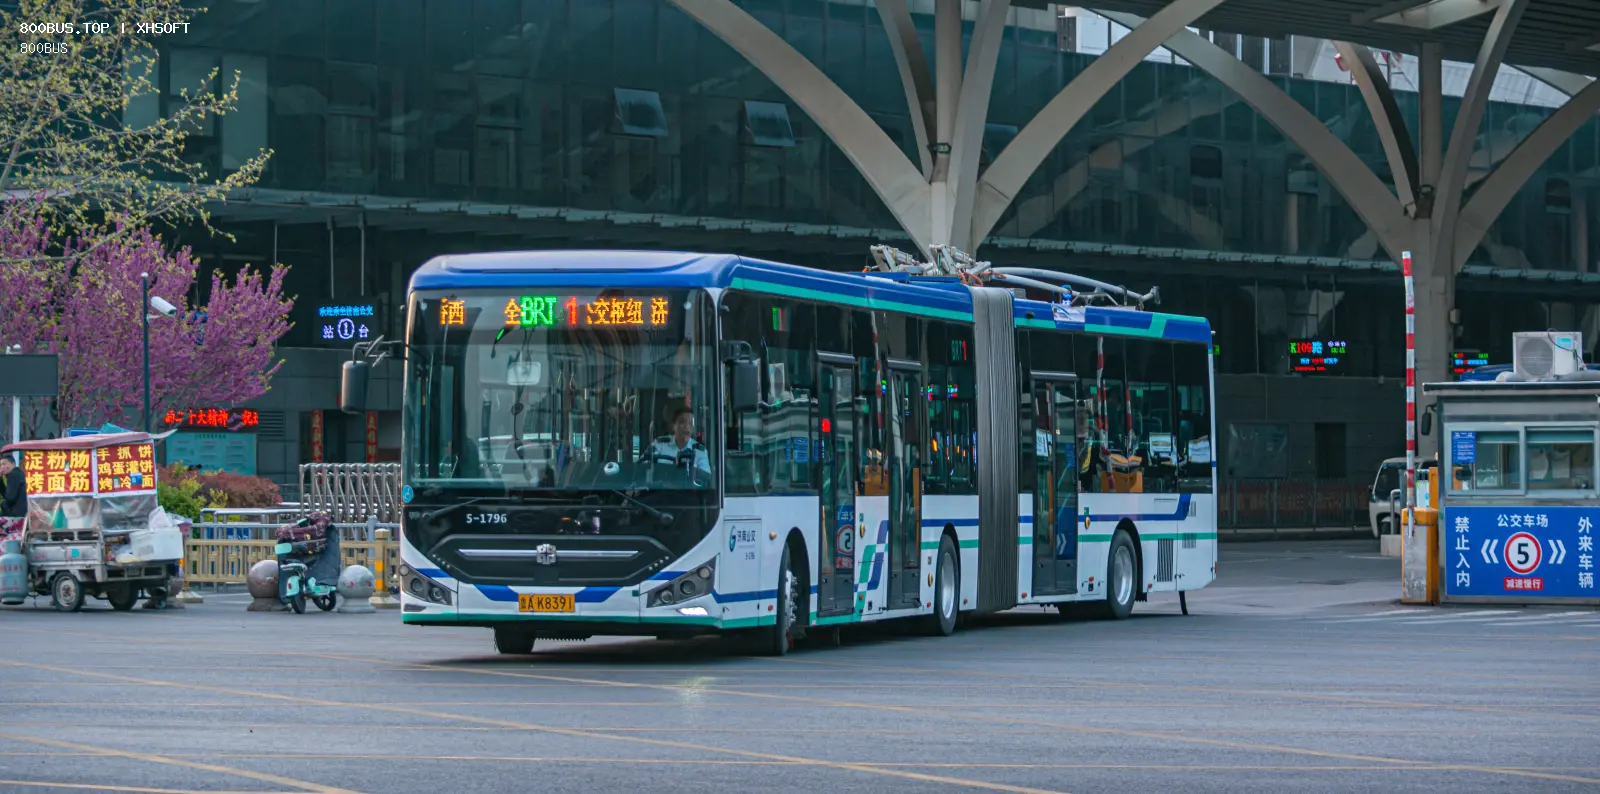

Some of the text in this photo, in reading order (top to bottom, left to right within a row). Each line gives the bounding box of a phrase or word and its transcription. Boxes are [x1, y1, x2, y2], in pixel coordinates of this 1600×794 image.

[521, 297, 557, 325] BRT
[565, 297, 577, 325] 1
[24, 449, 91, 472] 淀粉肠
[97, 445, 152, 461] 手抓饼
[97, 459, 153, 476] 鸡蛋灌饼
[25, 469, 91, 494] 烤面筋
[98, 474, 154, 491] 烤冷面
[466, 513, 508, 524] 5-1796
[1497, 513, 1549, 528] 公交车场
[1455, 516, 1471, 588] 禁止入内
[1516, 542, 1530, 565] 5
[1577, 516, 1594, 590] 外来车辆
[1506, 578, 1542, 589] 减速慢行
